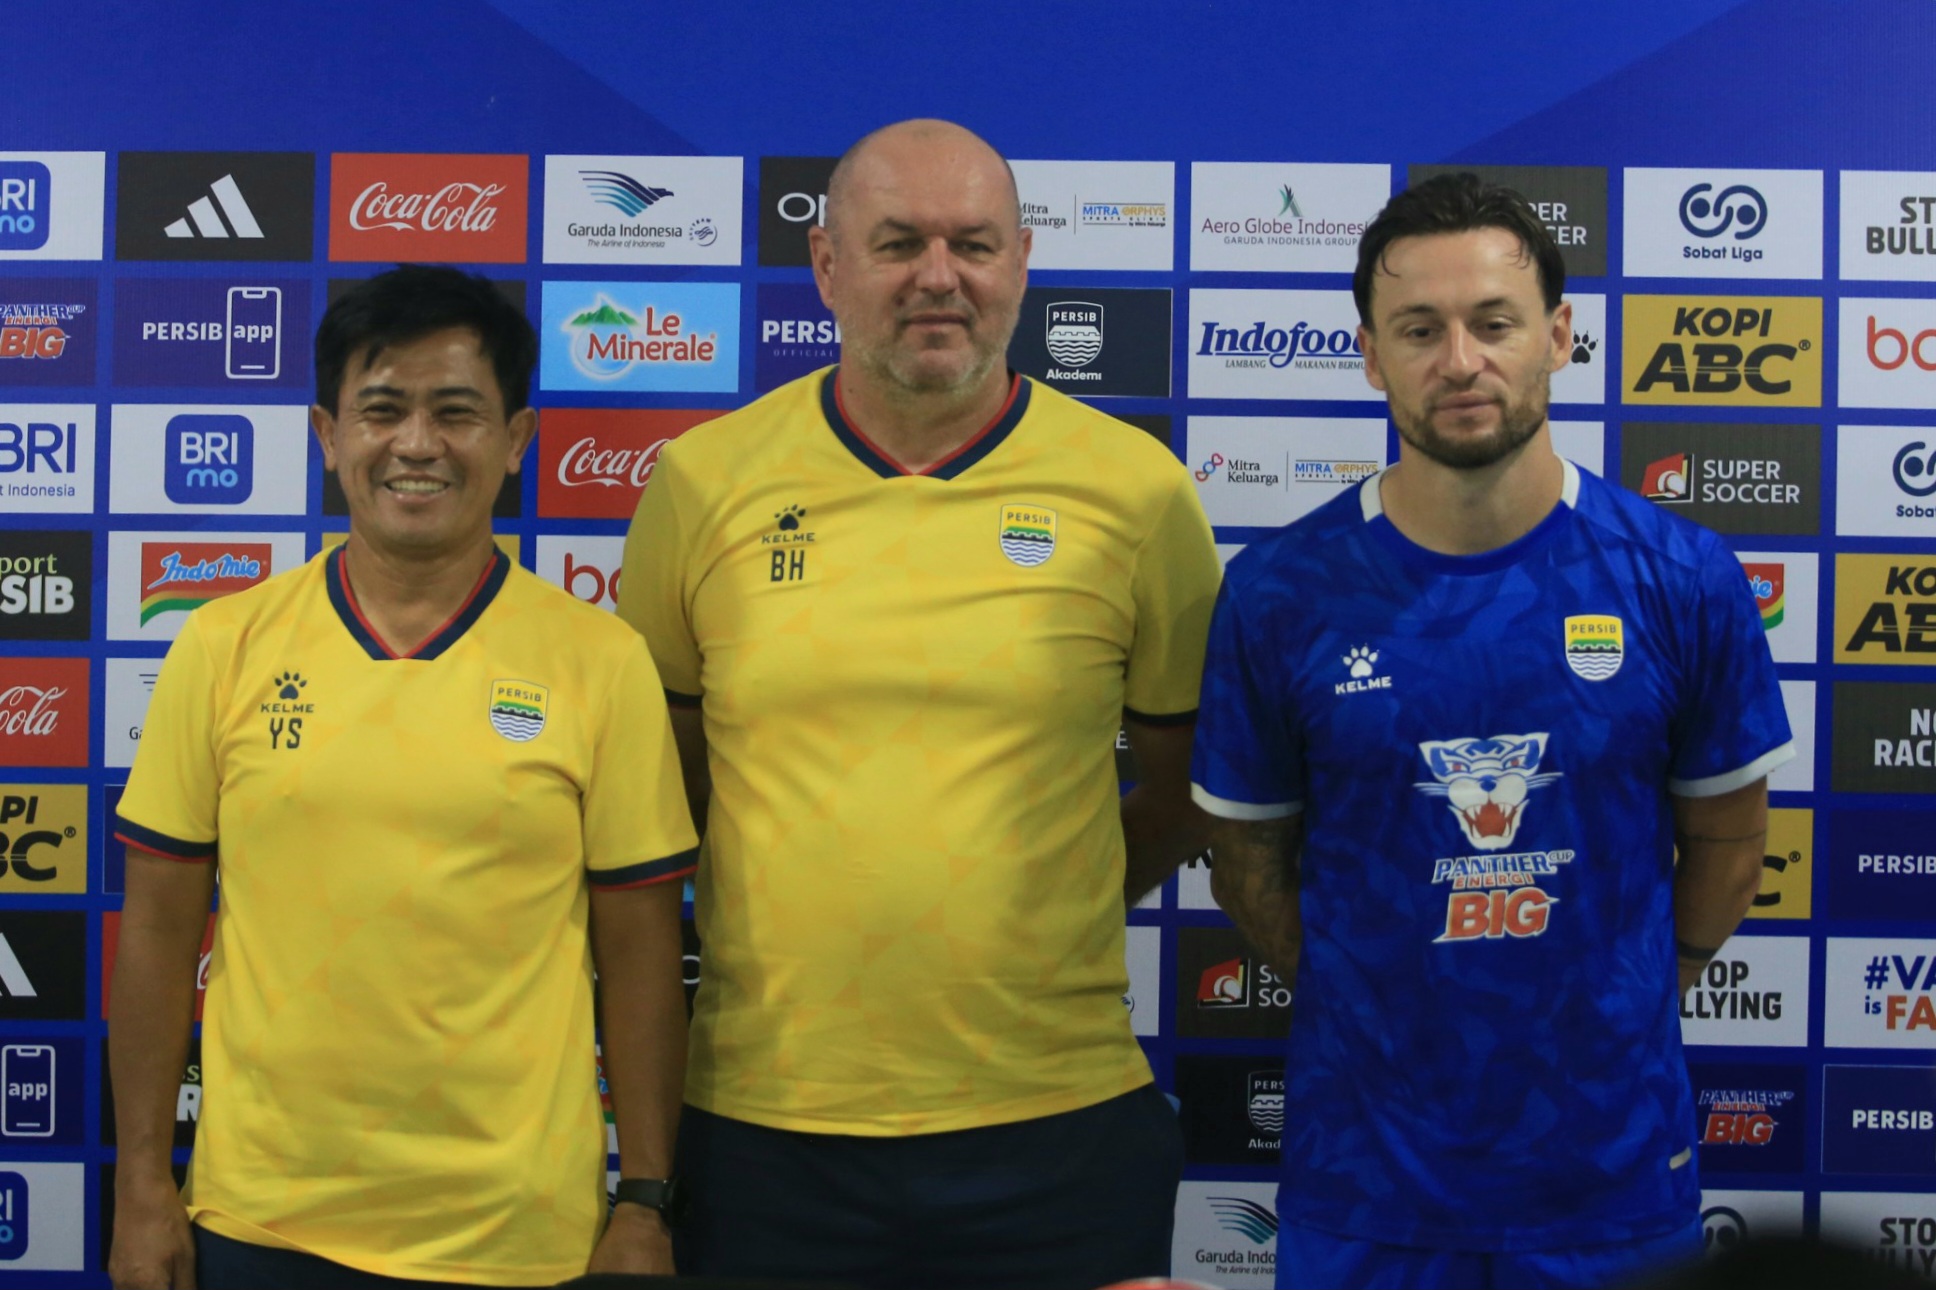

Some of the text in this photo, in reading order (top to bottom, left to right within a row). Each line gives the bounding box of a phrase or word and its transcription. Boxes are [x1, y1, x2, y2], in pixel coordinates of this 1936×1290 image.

[0, 179, 36, 211] RI
[349, 181, 507, 232] Coca-Cola
[1083, 206, 1119, 216] MITRA
[568, 222, 616, 237] Garuda
[620, 223, 683, 238] Indonesia
[1021, 215, 1067, 229] eluarga
[1202, 218, 1240, 234] Aero
[1245, 218, 1293, 235] Globe
[1224, 236, 1358, 246] GARUDA INDONESIA GROUP
[1683, 246, 1763, 262] Sobat Liga
[646, 306, 680, 337] Le
[1053, 311, 1097, 322] PERSIB
[1673, 307, 1773, 338] KOPI
[143, 322, 274, 343] PERSIB app
[0, 327, 67, 359] BIG
[587, 333, 714, 361] Minerale
[1225, 360, 1267, 369] LAMBANG
[1294, 360, 1337, 370] MAKANAN
[1633, 343, 1798, 395] ABC
[180, 432, 238, 465] BRI
[1228, 459, 1261, 471] Mitra
[1295, 463, 1332, 473] MITRA
[1703, 459, 1781, 480] SUPER
[186, 469, 239, 488] mo
[1228, 471, 1279, 487] Keluarga
[8, 483, 75, 497] Indonesia
[1702, 483, 1800, 504] SOCCER
[1006, 511, 1052, 525] PERSIB
[761, 532, 816, 544] KELME
[770, 550, 805, 582] BH
[1570, 623, 1618, 634] PERSIB
[497, 686, 542, 702] PERSIB
[1335, 676, 1392, 695] KELME
[260, 703, 315, 713] KELME
[269, 717, 303, 749] YS
[1874, 738, 1936, 767] RAC
[1431, 850, 1575, 884] PANTHER CUP
[1858, 855, 1936, 874] PERSIB
[1453, 872, 1534, 890] ENERGI
[1440, 886, 1553, 941] BIG
[1694, 960, 1749, 989] OP
[1865, 995, 1882, 1015] is
[8, 1081, 48, 1101] app
[1704, 1113, 1774, 1145] BIG
[1852, 1109, 1935, 1130] PERSIB
[1195, 1249, 1243, 1264] Garuda
